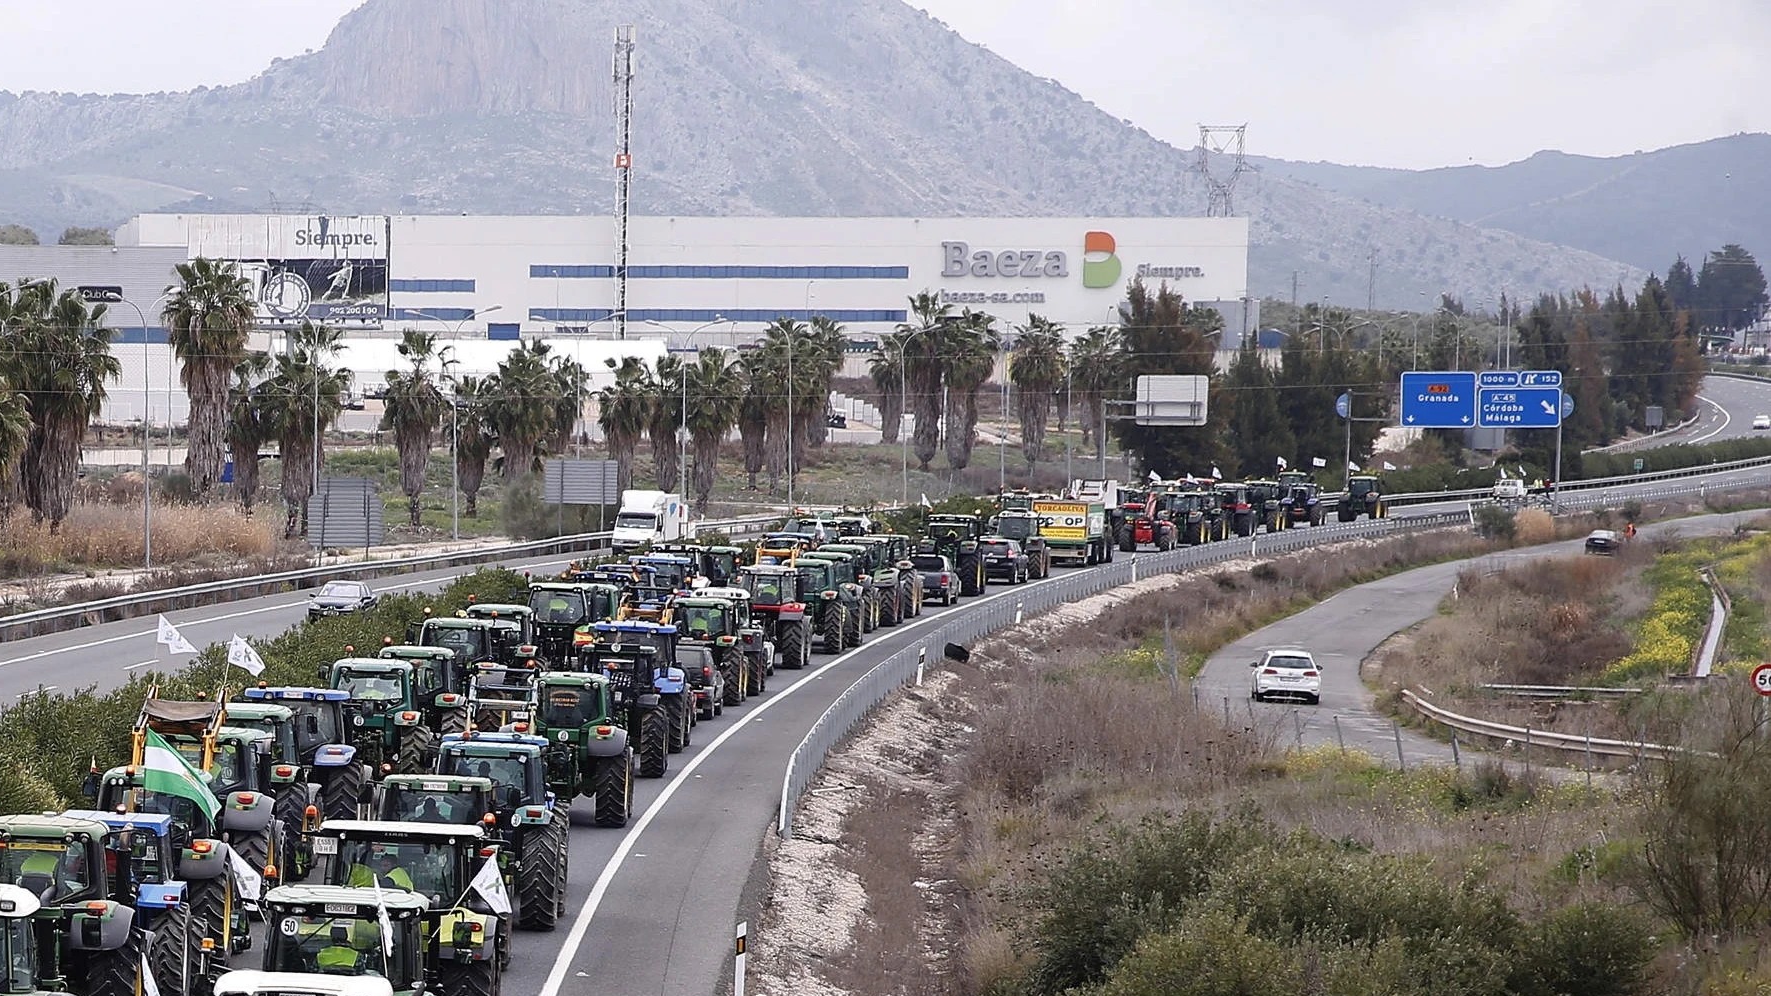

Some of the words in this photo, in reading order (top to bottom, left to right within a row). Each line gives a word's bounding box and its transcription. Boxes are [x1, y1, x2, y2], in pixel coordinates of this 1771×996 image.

[295, 229, 378, 249] Siempre.
[941, 240, 1069, 278] Baeza
[1136, 264, 1205, 281] Siempre.
[1418, 394, 1459, 402] Granada
[1485, 413, 1521, 423] Málaga
[284, 921, 296, 932] 50
